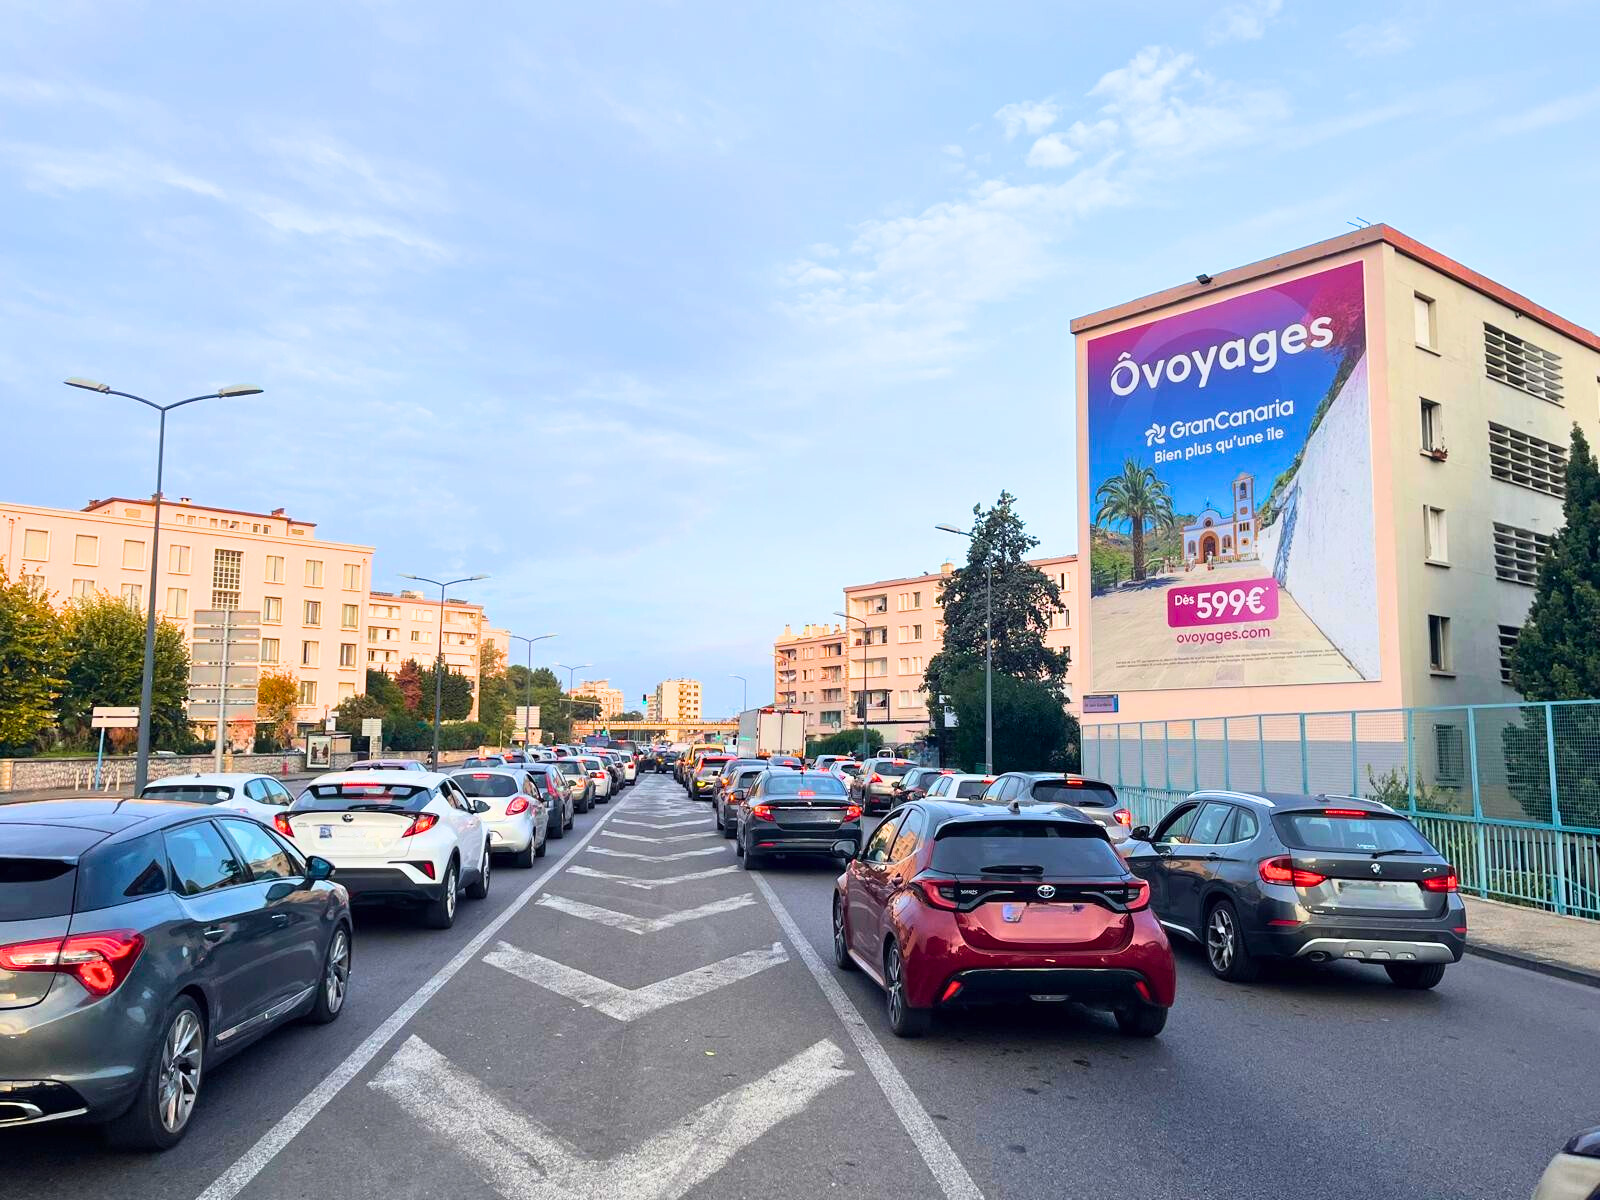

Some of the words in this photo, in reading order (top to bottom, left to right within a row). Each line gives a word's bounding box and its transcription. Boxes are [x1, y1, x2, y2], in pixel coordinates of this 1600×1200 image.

[1110, 316, 1334, 396] Ôvoyages
[1169, 399, 1294, 439] GranCanaria
[1154, 449, 1182, 463] Bien
[1185, 442, 1213, 460] plus
[1215, 434, 1264, 453] qu'une
[1266, 427, 1284, 441] île
[1174, 594, 1195, 606] Dès
[1176, 628, 1271, 645] ovoyages.com
